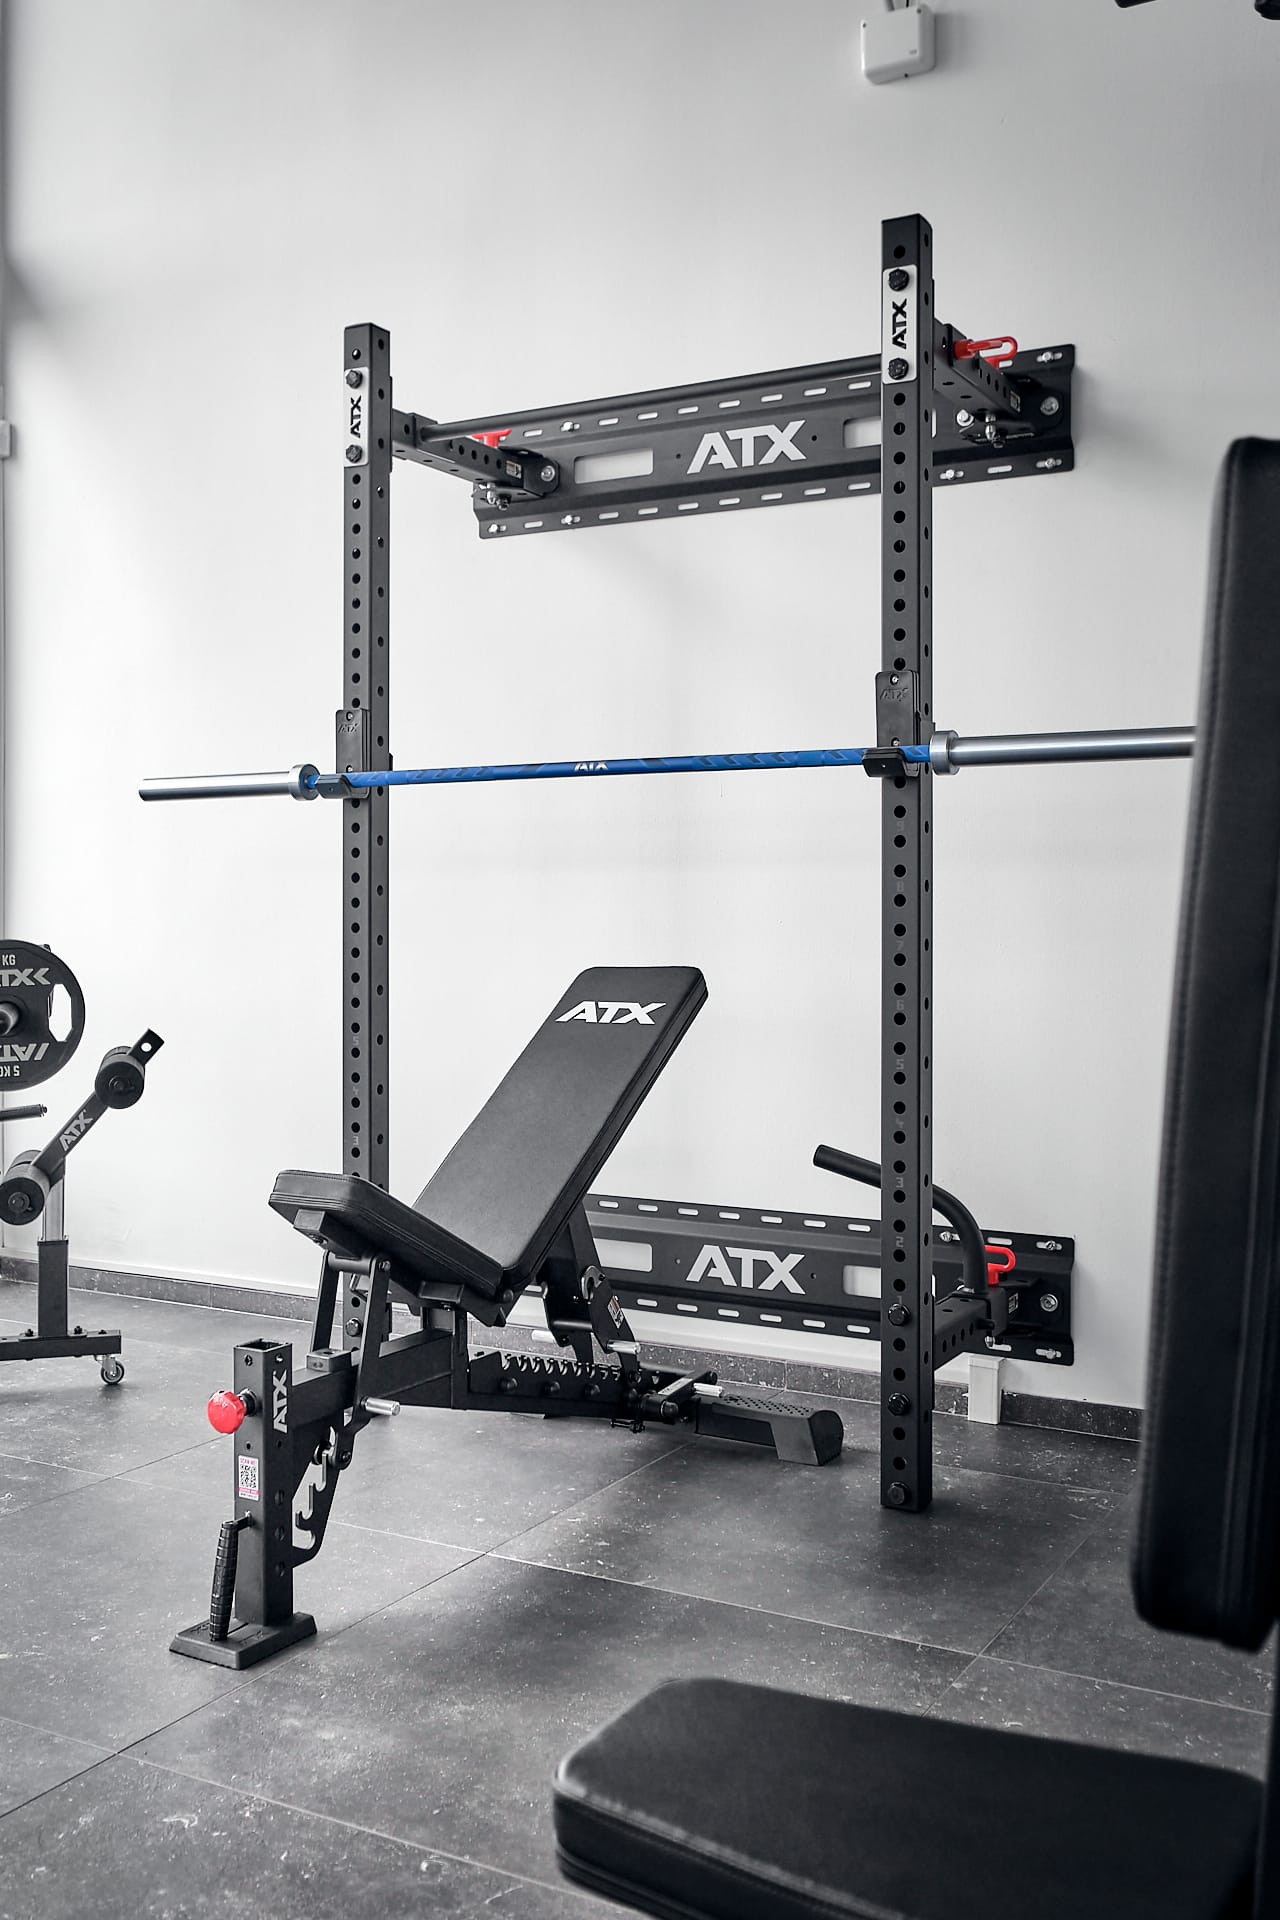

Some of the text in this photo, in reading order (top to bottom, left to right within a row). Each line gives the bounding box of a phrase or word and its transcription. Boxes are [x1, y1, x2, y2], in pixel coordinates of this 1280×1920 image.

[892, 298, 907, 350] ATX
[350, 395, 361, 439] ATX
[686, 419, 807, 475] ATX
[880, 687, 909, 701] ATX
[896, 940, 904, 951] 7
[2, 954, 16, 966] KG
[896, 999, 904, 1010] 6
[555, 1001, 666, 1025] ATX
[353, 1036, 359, 1045] 5
[896, 1059, 904, 1070] 5
[896, 1118, 904, 1129] 4
[59, 1111, 93, 1151] ATX
[353, 1135, 359, 1145] 3
[896, 1177, 904, 1188] 3
[896, 1236, 904, 1248] 2
[685, 1244, 806, 1295] ATX
[272, 1369, 287, 1434] ATX
